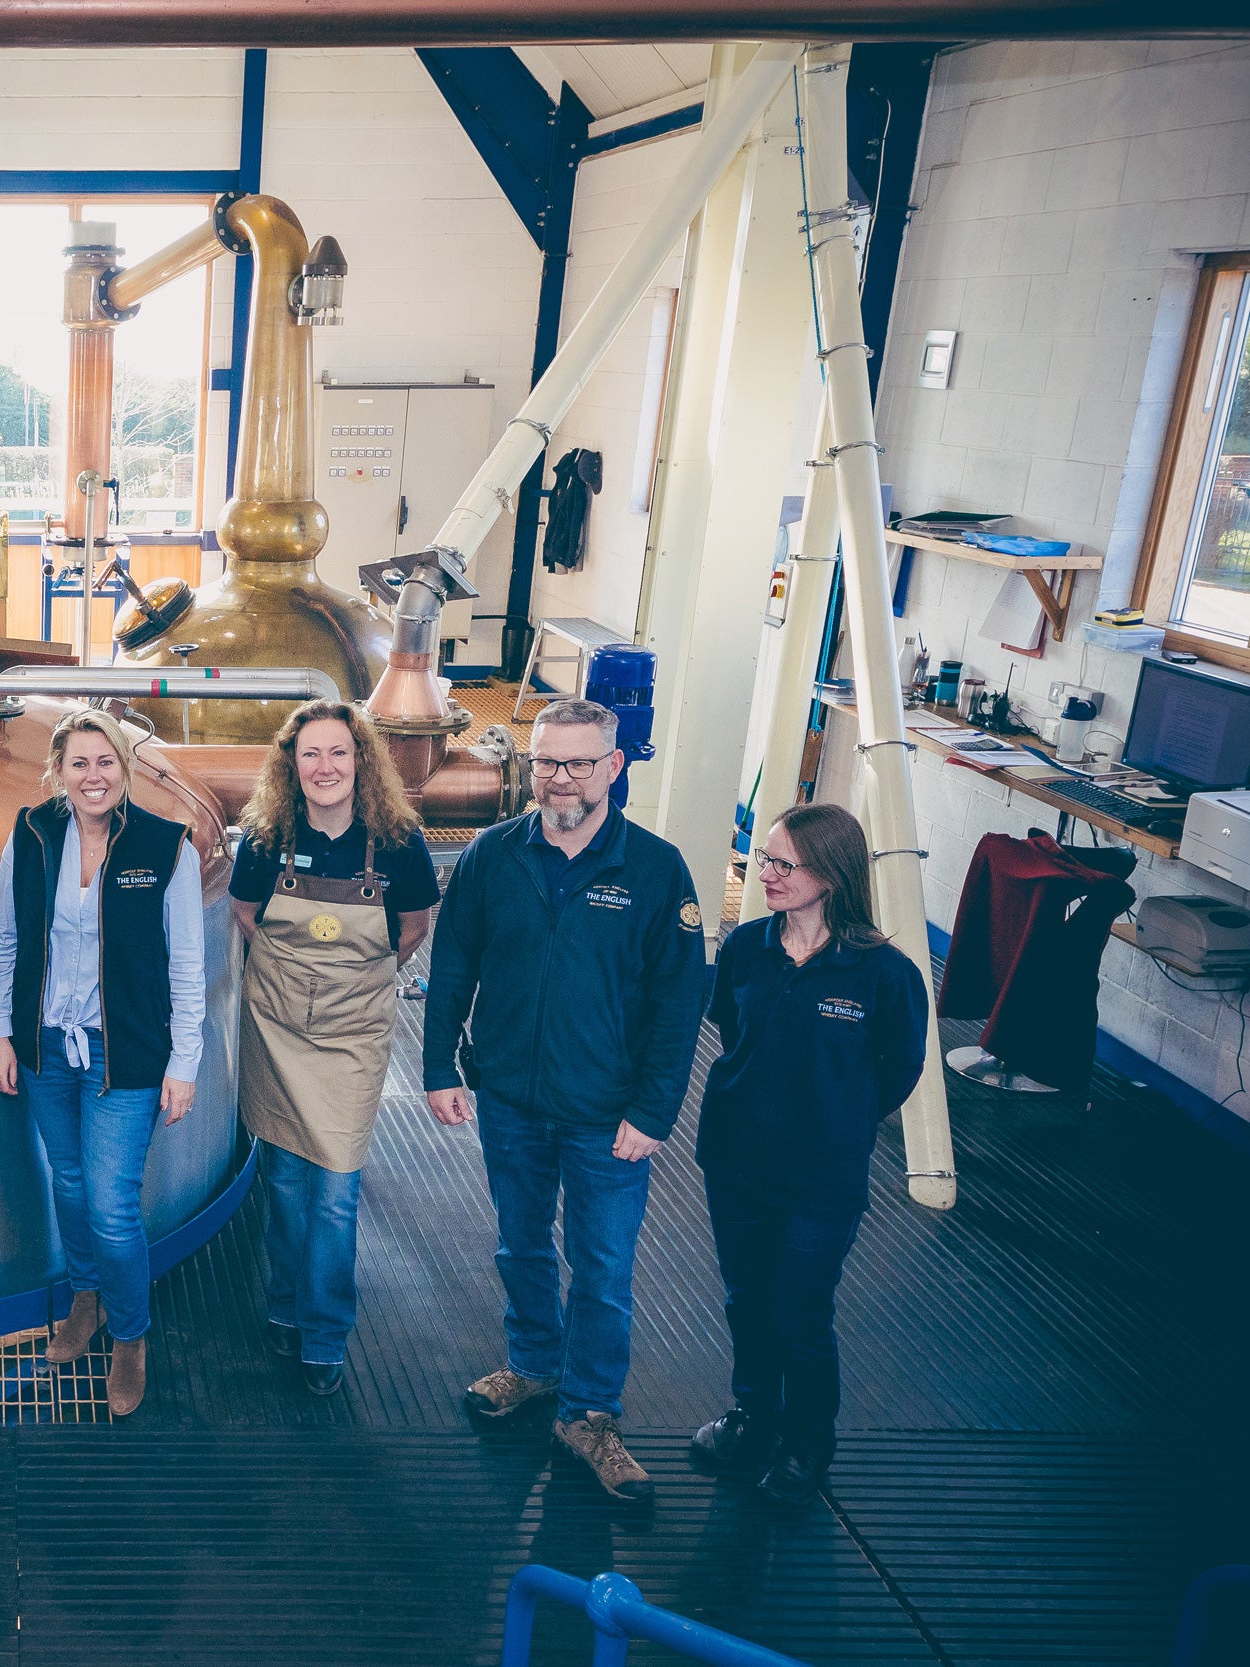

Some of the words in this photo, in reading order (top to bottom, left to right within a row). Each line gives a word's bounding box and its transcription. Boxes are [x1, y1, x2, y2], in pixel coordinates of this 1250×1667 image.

[131, 876, 158, 884] ENGLISH
[586, 892, 601, 900] THE
[601, 895, 632, 906] ENGLISH
[817, 1003, 833, 1012] THE
[835, 1006, 865, 1019] ENGLISH
